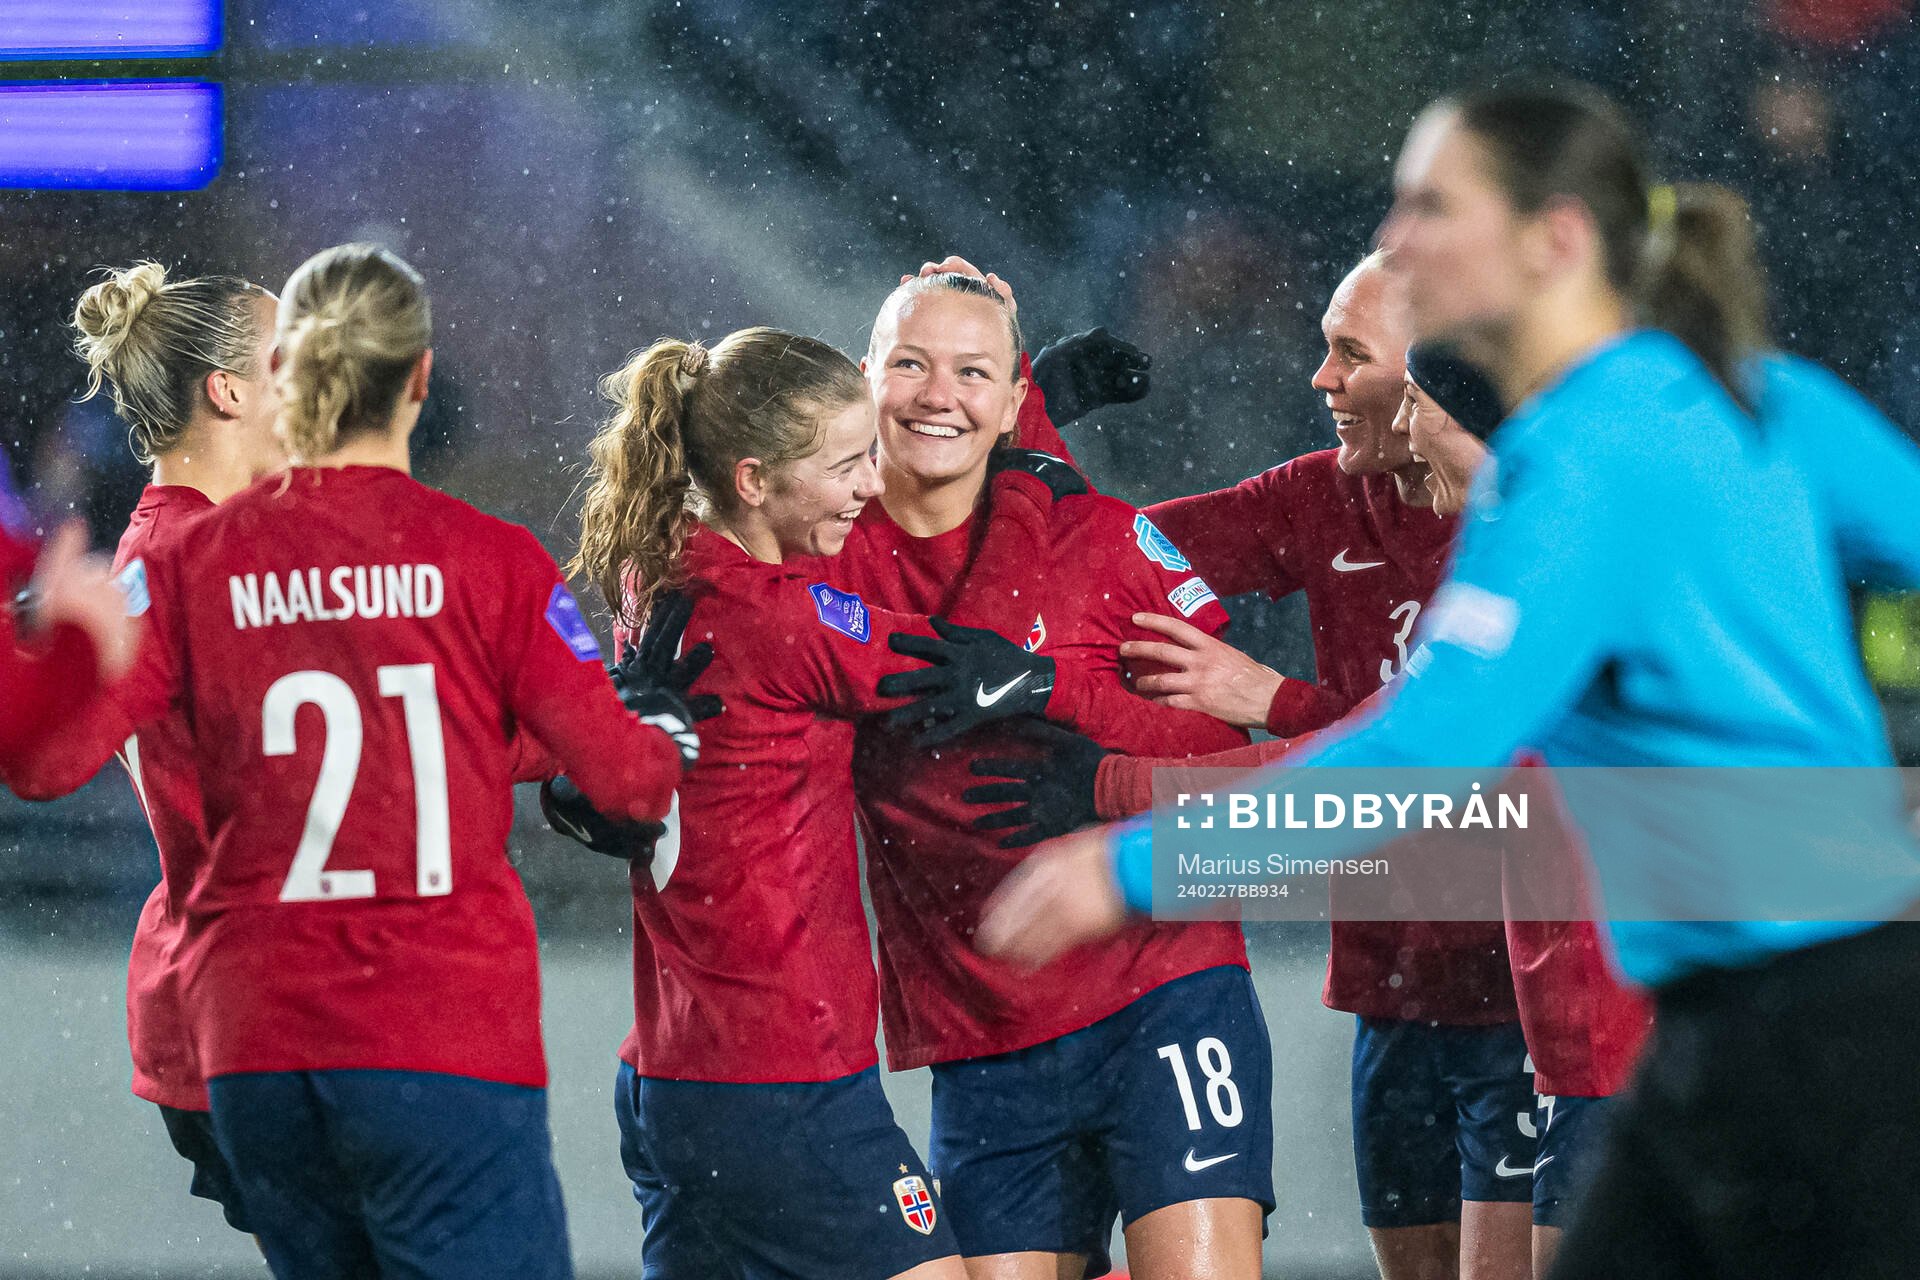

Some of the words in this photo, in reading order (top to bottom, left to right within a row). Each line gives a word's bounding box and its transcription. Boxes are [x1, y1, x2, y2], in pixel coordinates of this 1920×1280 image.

[229, 563, 443, 630] NAALSUND
[1379, 600, 1422, 684] 3
[262, 663, 454, 903] 21
[1157, 1036, 1245, 1131] 18
